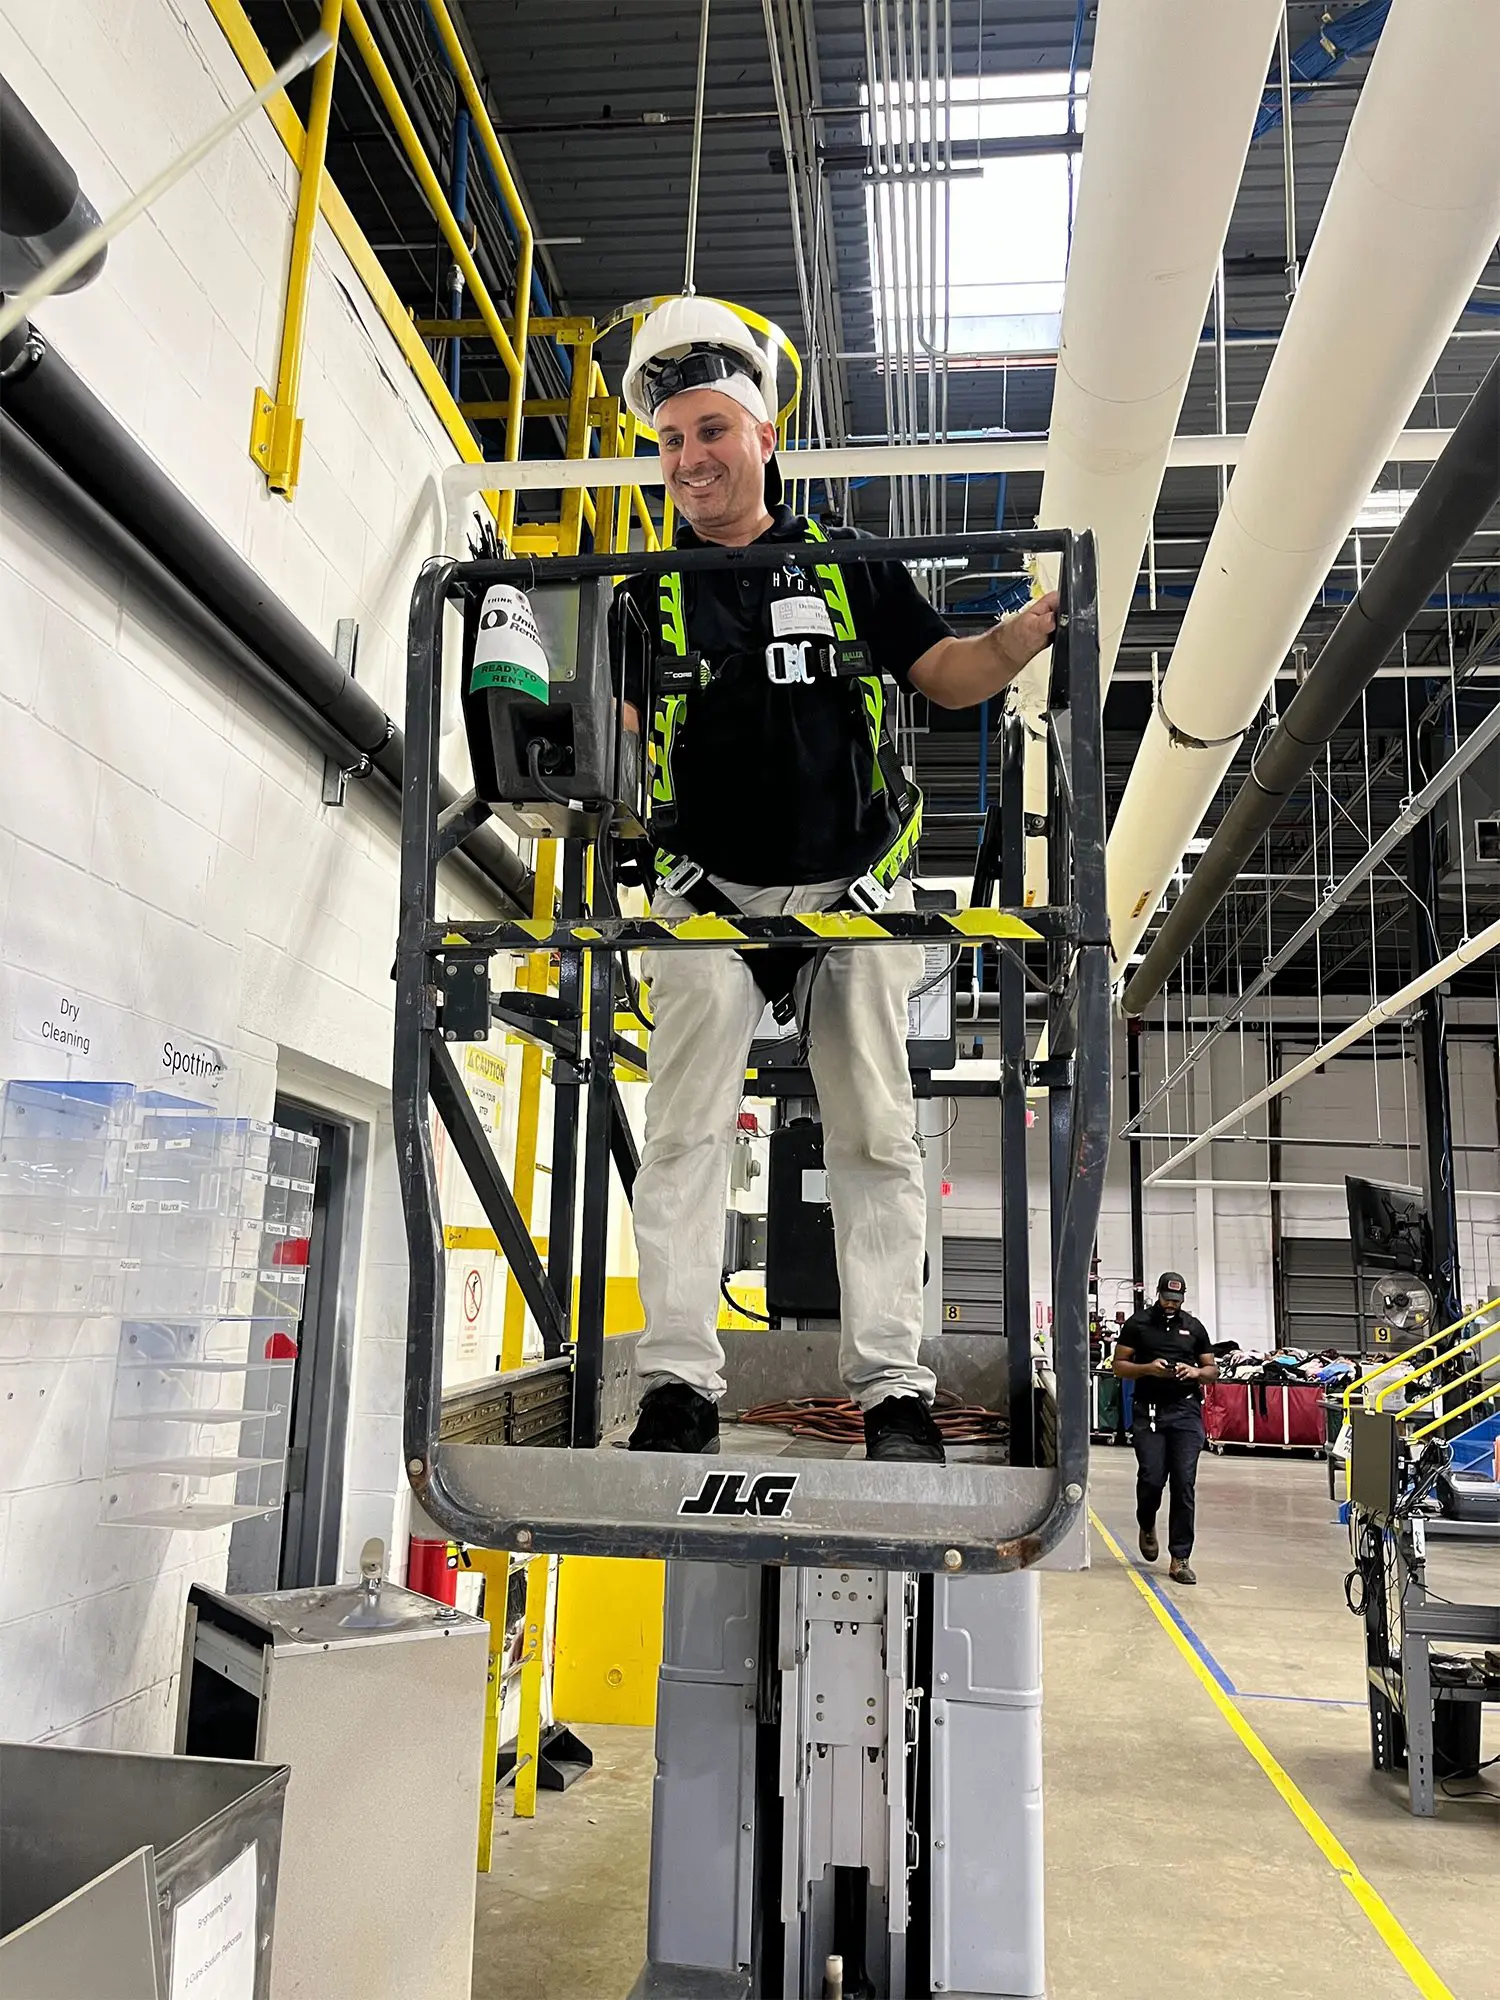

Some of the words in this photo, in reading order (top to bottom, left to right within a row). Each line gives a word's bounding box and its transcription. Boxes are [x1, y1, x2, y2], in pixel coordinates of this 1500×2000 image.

[487, 597, 513, 605] THINK
[481, 664, 520, 675] READY
[523, 671, 537, 683] TO
[672, 671, 693, 679] CORE
[491, 674, 524, 687] RENT
[60, 998, 80, 1022] Dry
[41, 1021, 91, 1055] Cleaning
[475, 1054, 507, 1082] CAUTION
[486, 1092, 496, 1103] YOUR
[479, 1105, 489, 1116] STEP
[948, 1306, 958, 1319] 8
[1378, 1327, 1388, 1341] 9
[677, 1471, 800, 1518] JLG
